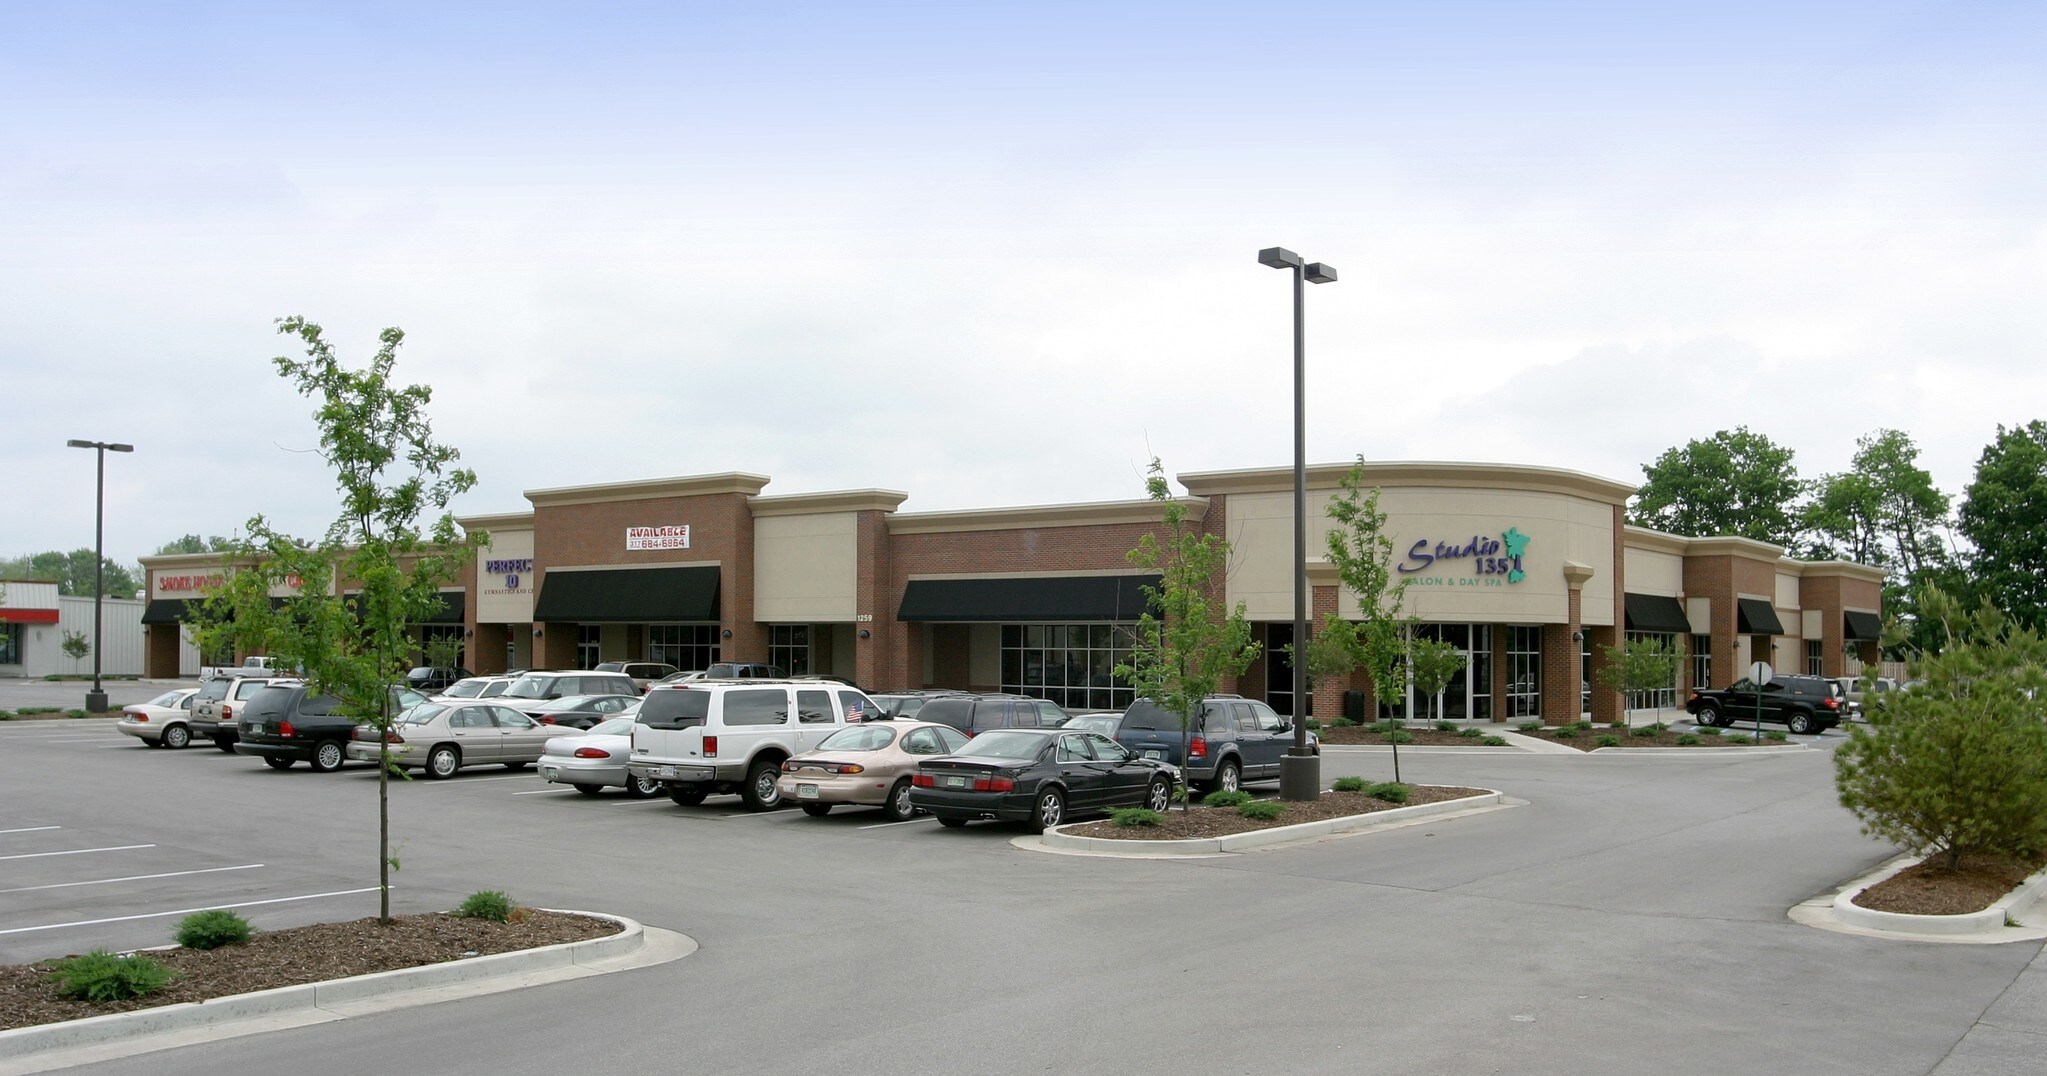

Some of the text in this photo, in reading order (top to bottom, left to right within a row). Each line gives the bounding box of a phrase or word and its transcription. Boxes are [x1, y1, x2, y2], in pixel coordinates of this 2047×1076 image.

[630, 527, 686, 538] AVAILABLE
[1397, 535, 1500, 573] Studio
[1475, 557, 1509, 575] 135
[505, 574, 519, 589] 10
[1409, 577, 1503, 587] ALON & DAY SPA
